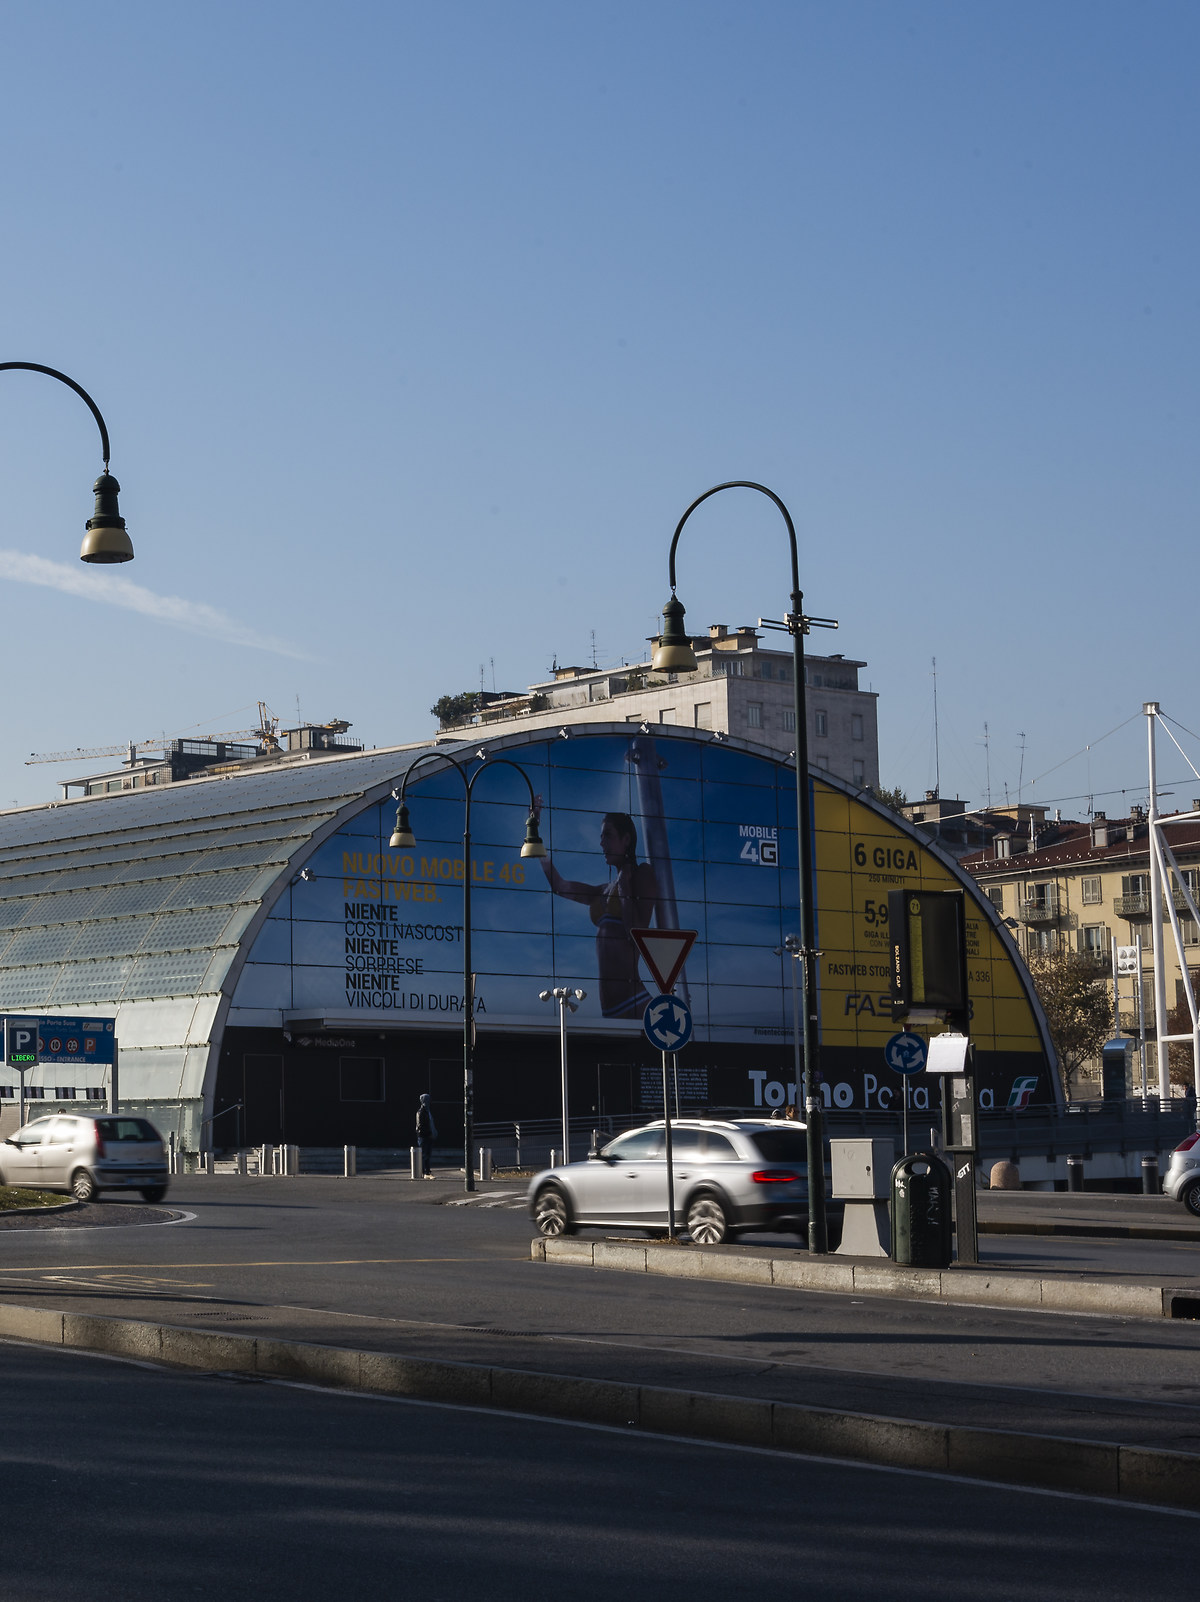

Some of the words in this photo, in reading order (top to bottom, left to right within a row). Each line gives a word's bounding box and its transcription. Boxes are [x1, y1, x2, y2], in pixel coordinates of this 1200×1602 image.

[739, 825, 777, 839] MOBILE
[740, 841, 778, 865] 4G
[854, 843, 867, 867] 6
[873, 848, 918, 871] GIGA
[342, 852, 415, 876] NUOVO
[421, 857, 495, 882] MOBLE
[499, 863, 525, 884] 4G
[868, 873, 881, 883] 250
[882, 874, 905, 884] MINUTI
[343, 877, 442, 903] FASTWEB.
[345, 903, 398, 921] NIENTE
[864, 900, 888, 927] 5,9
[911, 903, 919, 911] 71
[345, 921, 389, 937] COSTI
[393, 924, 465, 942] NASCOST
[345, 938, 399, 956] NIENTE
[346, 956, 424, 975] SORPRESE
[828, 963, 866, 976] FASTWEB
[869, 965, 891, 977] STOR
[346, 973, 400, 991] NIENTE
[975, 971, 991, 982] 336
[345, 991, 405, 1009] VINCOLI
[410, 993, 423, 1010] DI
[16, 1031, 31, 1050] P
[314, 1037, 356, 1047] MediaOne
[864, 1073, 928, 1109] Pota
